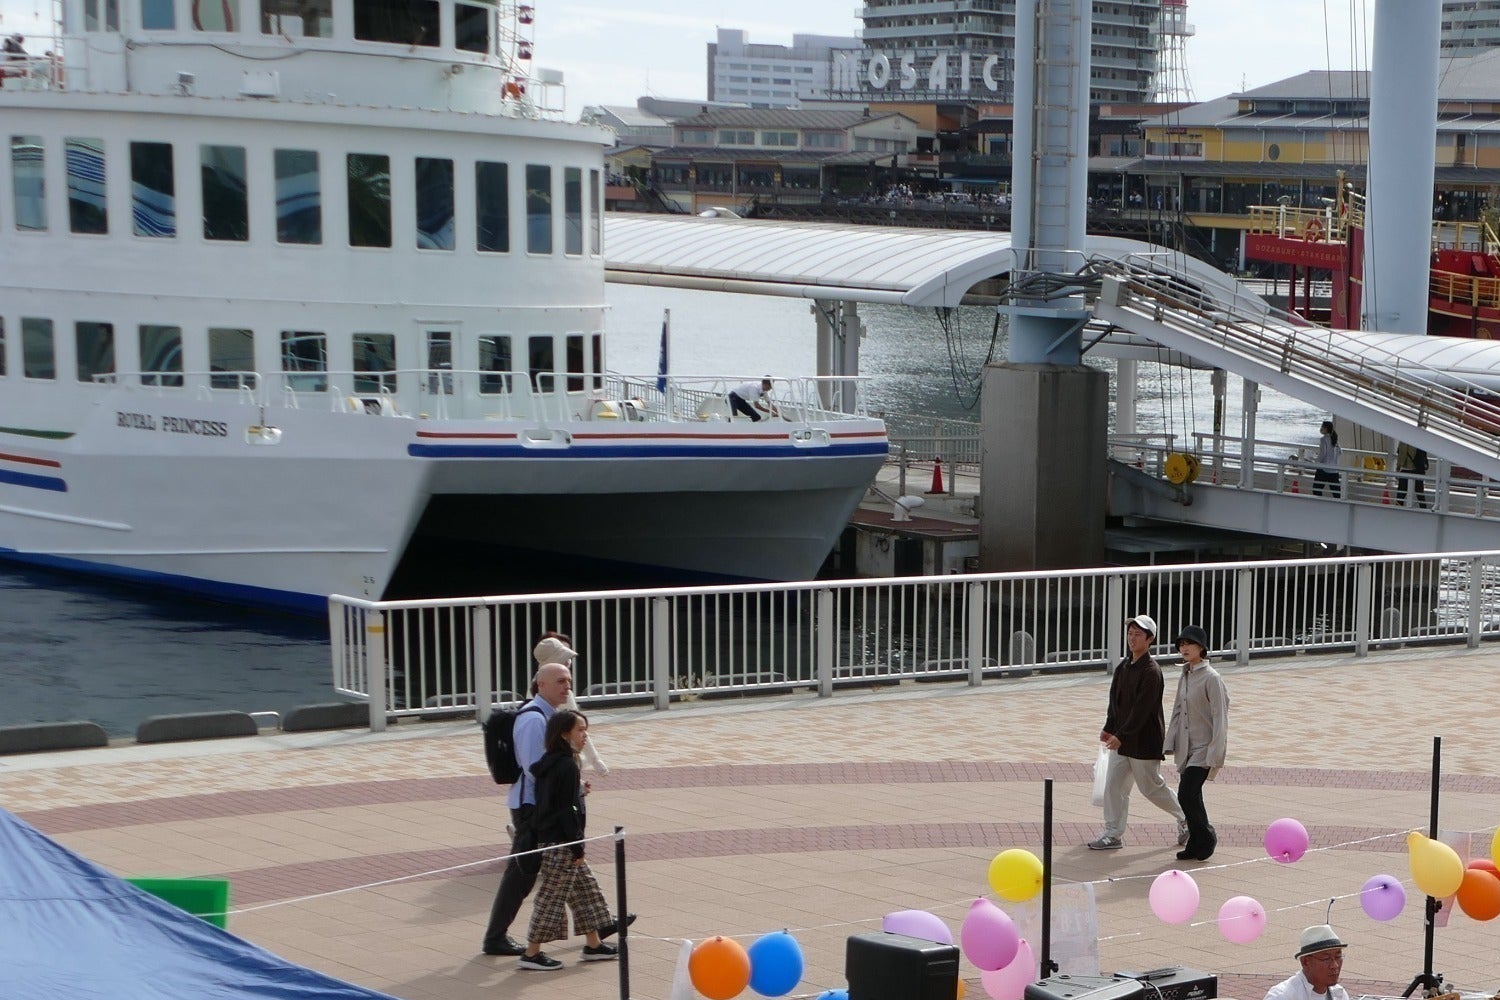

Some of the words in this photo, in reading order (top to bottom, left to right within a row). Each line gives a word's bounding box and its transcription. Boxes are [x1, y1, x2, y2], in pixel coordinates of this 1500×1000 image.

[832, 49, 998, 92] MOSAIC
[116, 411, 156, 431] ROYAL
[162, 416, 228, 437] PRINCESS
